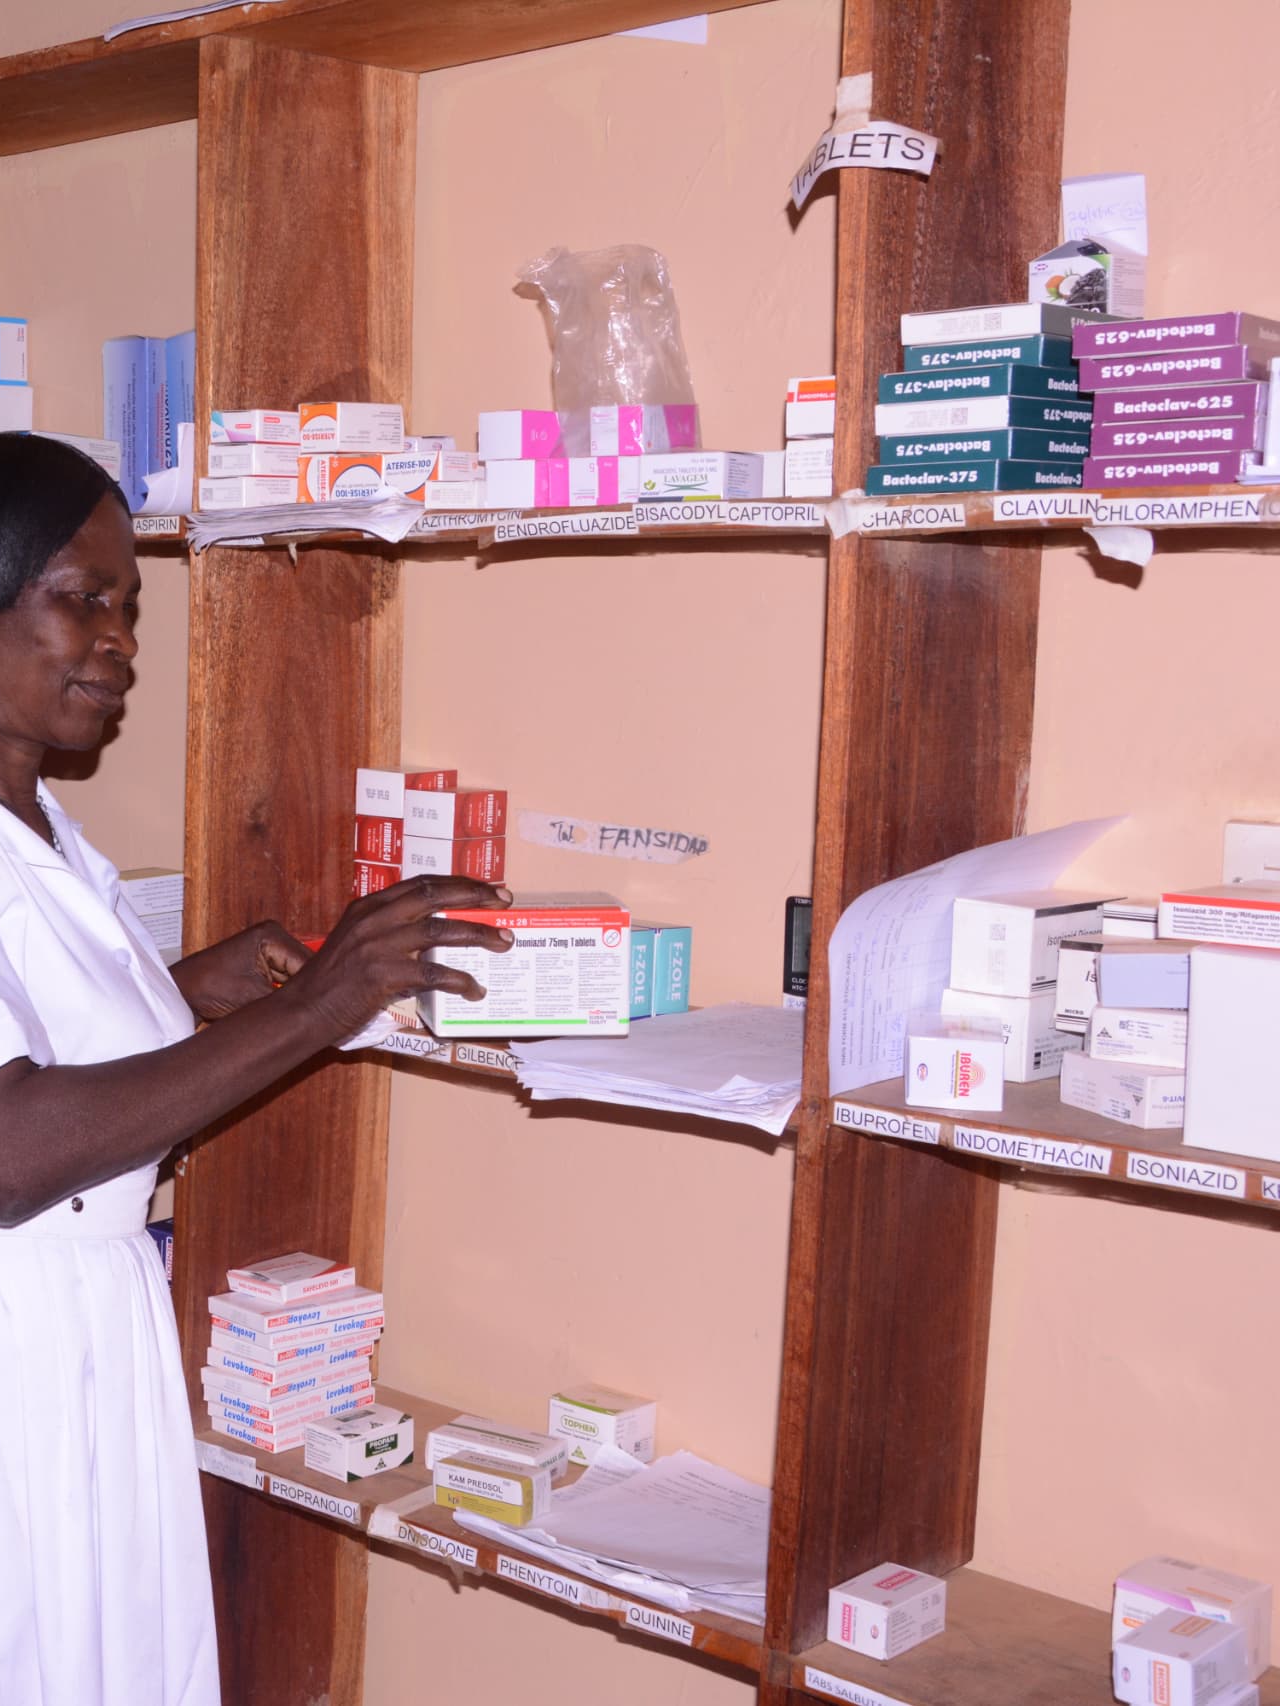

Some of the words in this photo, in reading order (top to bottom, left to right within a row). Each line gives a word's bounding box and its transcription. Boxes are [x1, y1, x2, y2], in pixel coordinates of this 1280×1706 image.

[794, 133, 925, 195] TABLETS
[1095, 324, 1215, 345] Bactoclav-625
[921, 347, 1021, 365] Bactoclav-375
[1101, 357, 1222, 378] Bactoclav-625
[895, 376, 991, 395] Bactoclav-375
[1113, 396, 1233, 415] Bactoclav-625
[1113, 428, 1233, 446] Bactoclav-625
[895, 440, 991, 457] Bactoclav-375
[385, 459, 432, 471] ATERISE-100
[1103, 462, 1220, 478] Bactoclav-625
[664, 474, 709, 484] LAVAGEM
[882, 471, 978, 487] Bactoclav-375
[1035, 472, 1082, 485] Bactoclav-3
[635, 506, 726, 522] BISACODYL
[728, 506, 820, 522] CAPTOPRIL
[1000, 498, 1099, 517] CLAVULIN
[135, 518, 178, 532] ASPIRIN
[497, 516, 636, 539] BENDROFLUAZIDE
[862, 508, 964, 528] CHARCOAL
[495, 918, 508, 926] 24
[515, 937, 547, 947] Isoniazid
[548, 937, 569, 949] 75mg
[570, 937, 596, 947] Tablets
[634, 944, 646, 1004] F-ZOLE
[671, 942, 683, 1001] F-ZOLE
[958, 1053, 971, 1097] IBUREN
[836, 1106, 937, 1142] IBUPROFEN
[955, 1131, 1105, 1170] INDOMETHACIN
[1131, 1158, 1238, 1191] ISONIAZID
[564, 1417, 596, 1432] TOPHEN
[448, 1473, 466, 1485] KAM
[467, 1477, 503, 1494] PREDSOL
[272, 1481, 358, 1520] PROPRANOLOL
[499, 1559, 578, 1600] PHENYTOIN
[629, 1606, 692, 1641] QUININE
[808, 1671, 833, 1692] TABS
